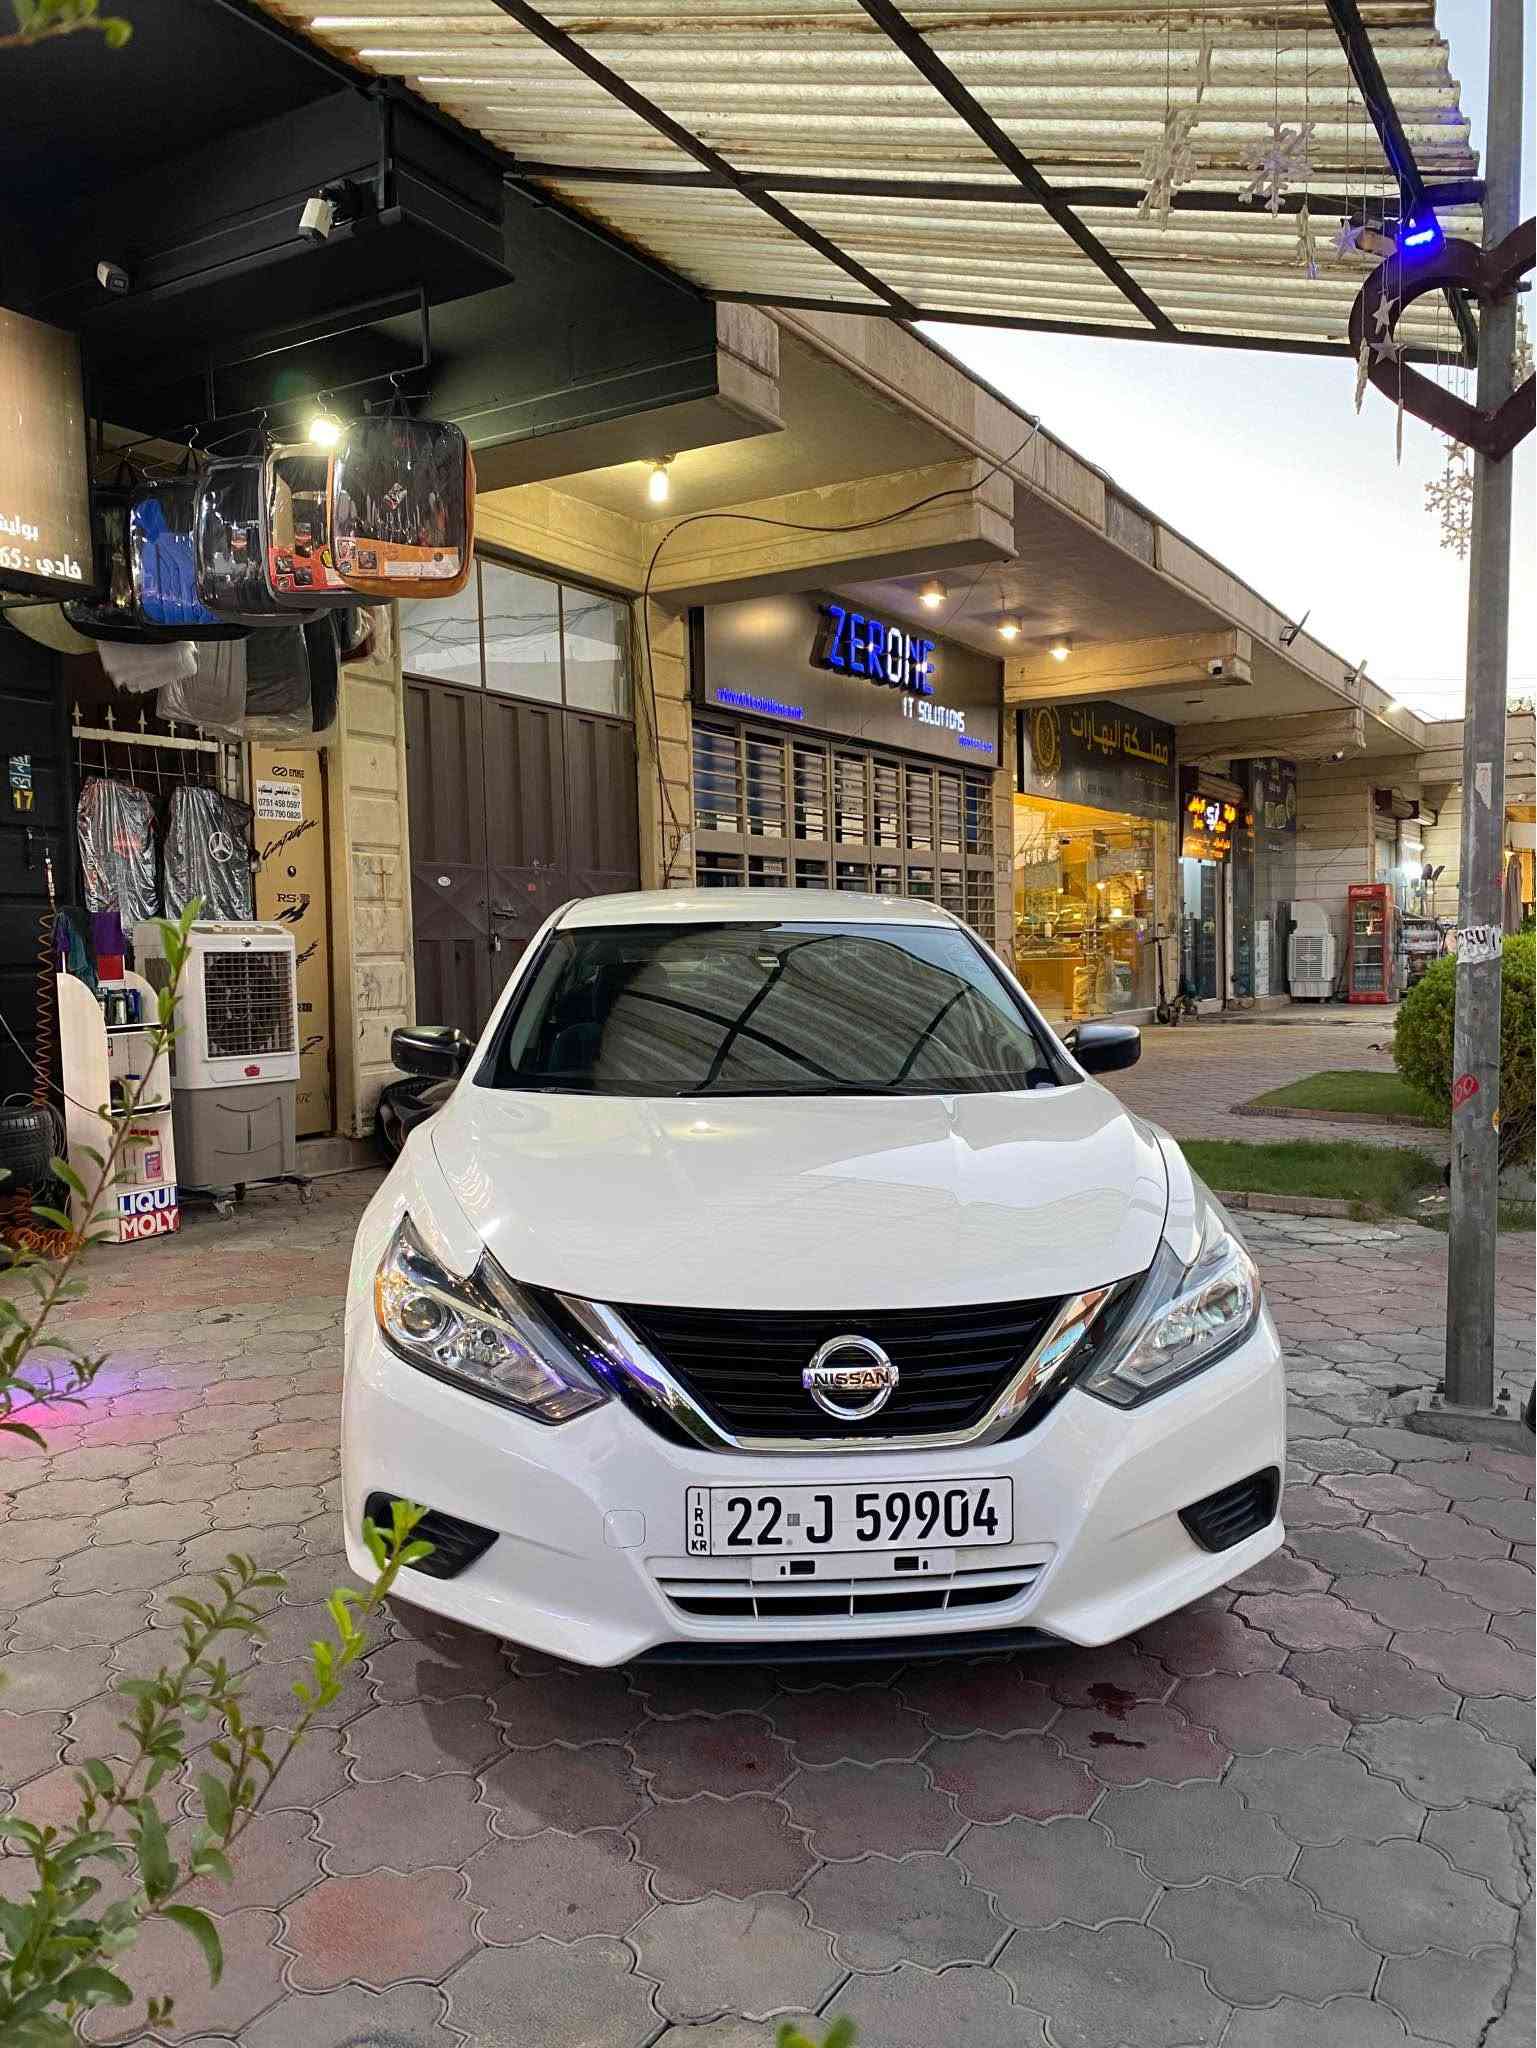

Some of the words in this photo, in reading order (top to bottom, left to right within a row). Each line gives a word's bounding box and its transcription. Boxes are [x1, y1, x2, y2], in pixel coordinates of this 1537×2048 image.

[826, 603, 937, 695] ZERONE
[903, 696, 914, 719] IT
[918, 700, 966, 733] SOLUTIONS
[15, 789, 33, 810] 17
[119, 1186, 177, 1216] LIQUI
[121, 1208, 179, 1240] MOLY
[814, 1371, 889, 1385] NISSAN
[726, 1496, 783, 1546] 22
[806, 1494, 833, 1544] J
[855, 1487, 999, 1542] 59904
